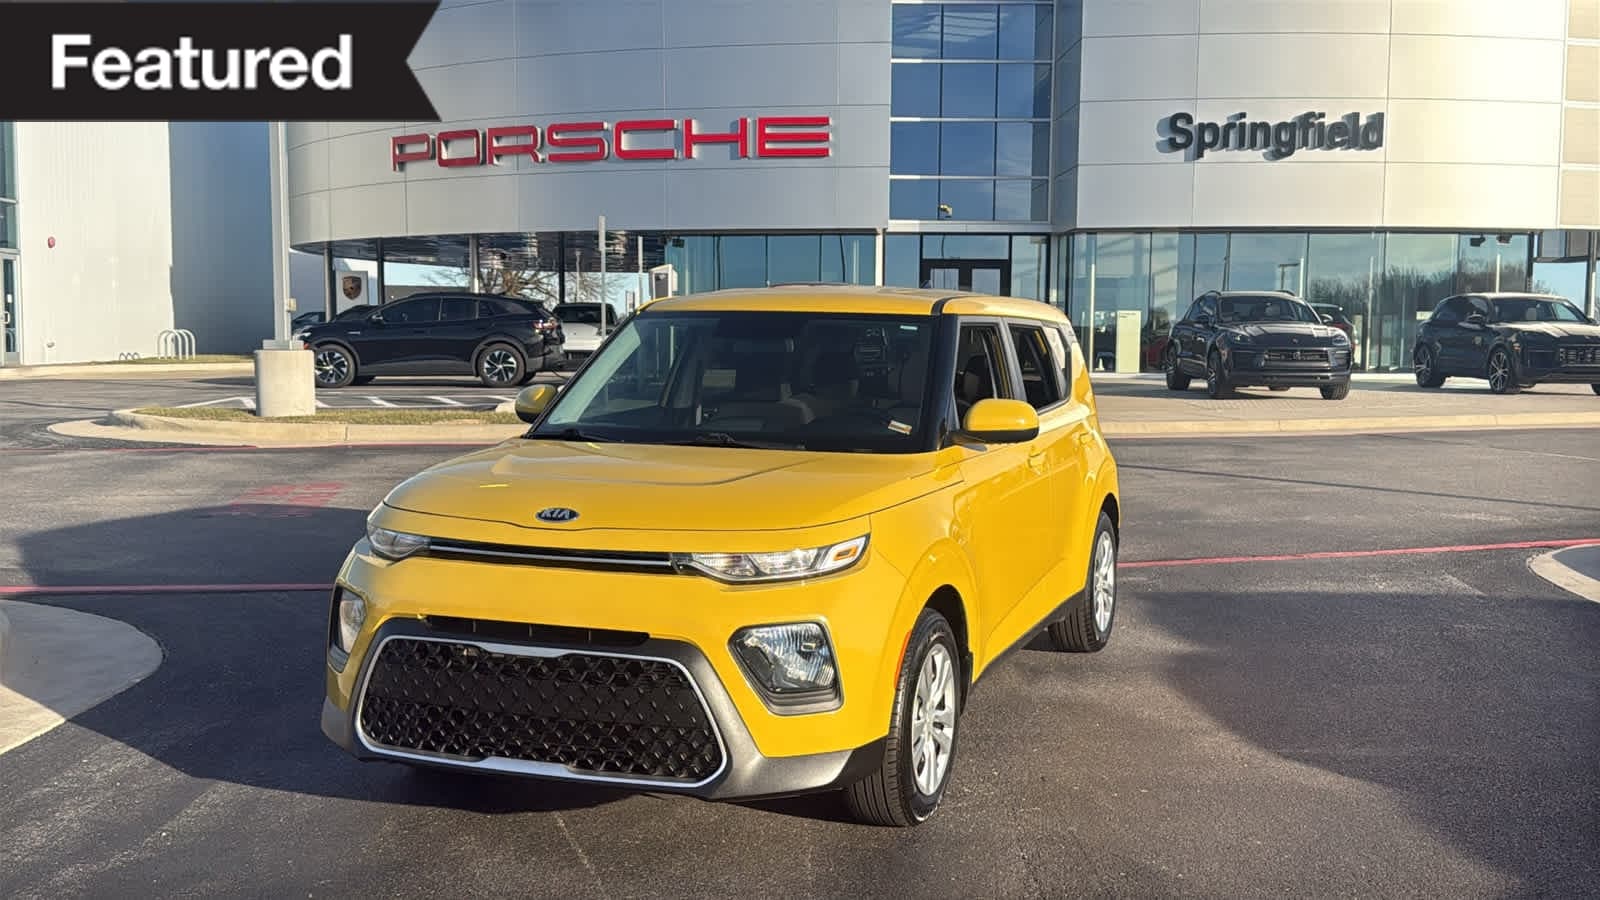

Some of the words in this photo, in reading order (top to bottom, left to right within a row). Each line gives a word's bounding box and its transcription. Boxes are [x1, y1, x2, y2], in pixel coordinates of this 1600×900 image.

[391, 116, 831, 171] PORSCHE
[1166, 111, 1385, 160] Springfield
[540, 508, 571, 520] KIA
